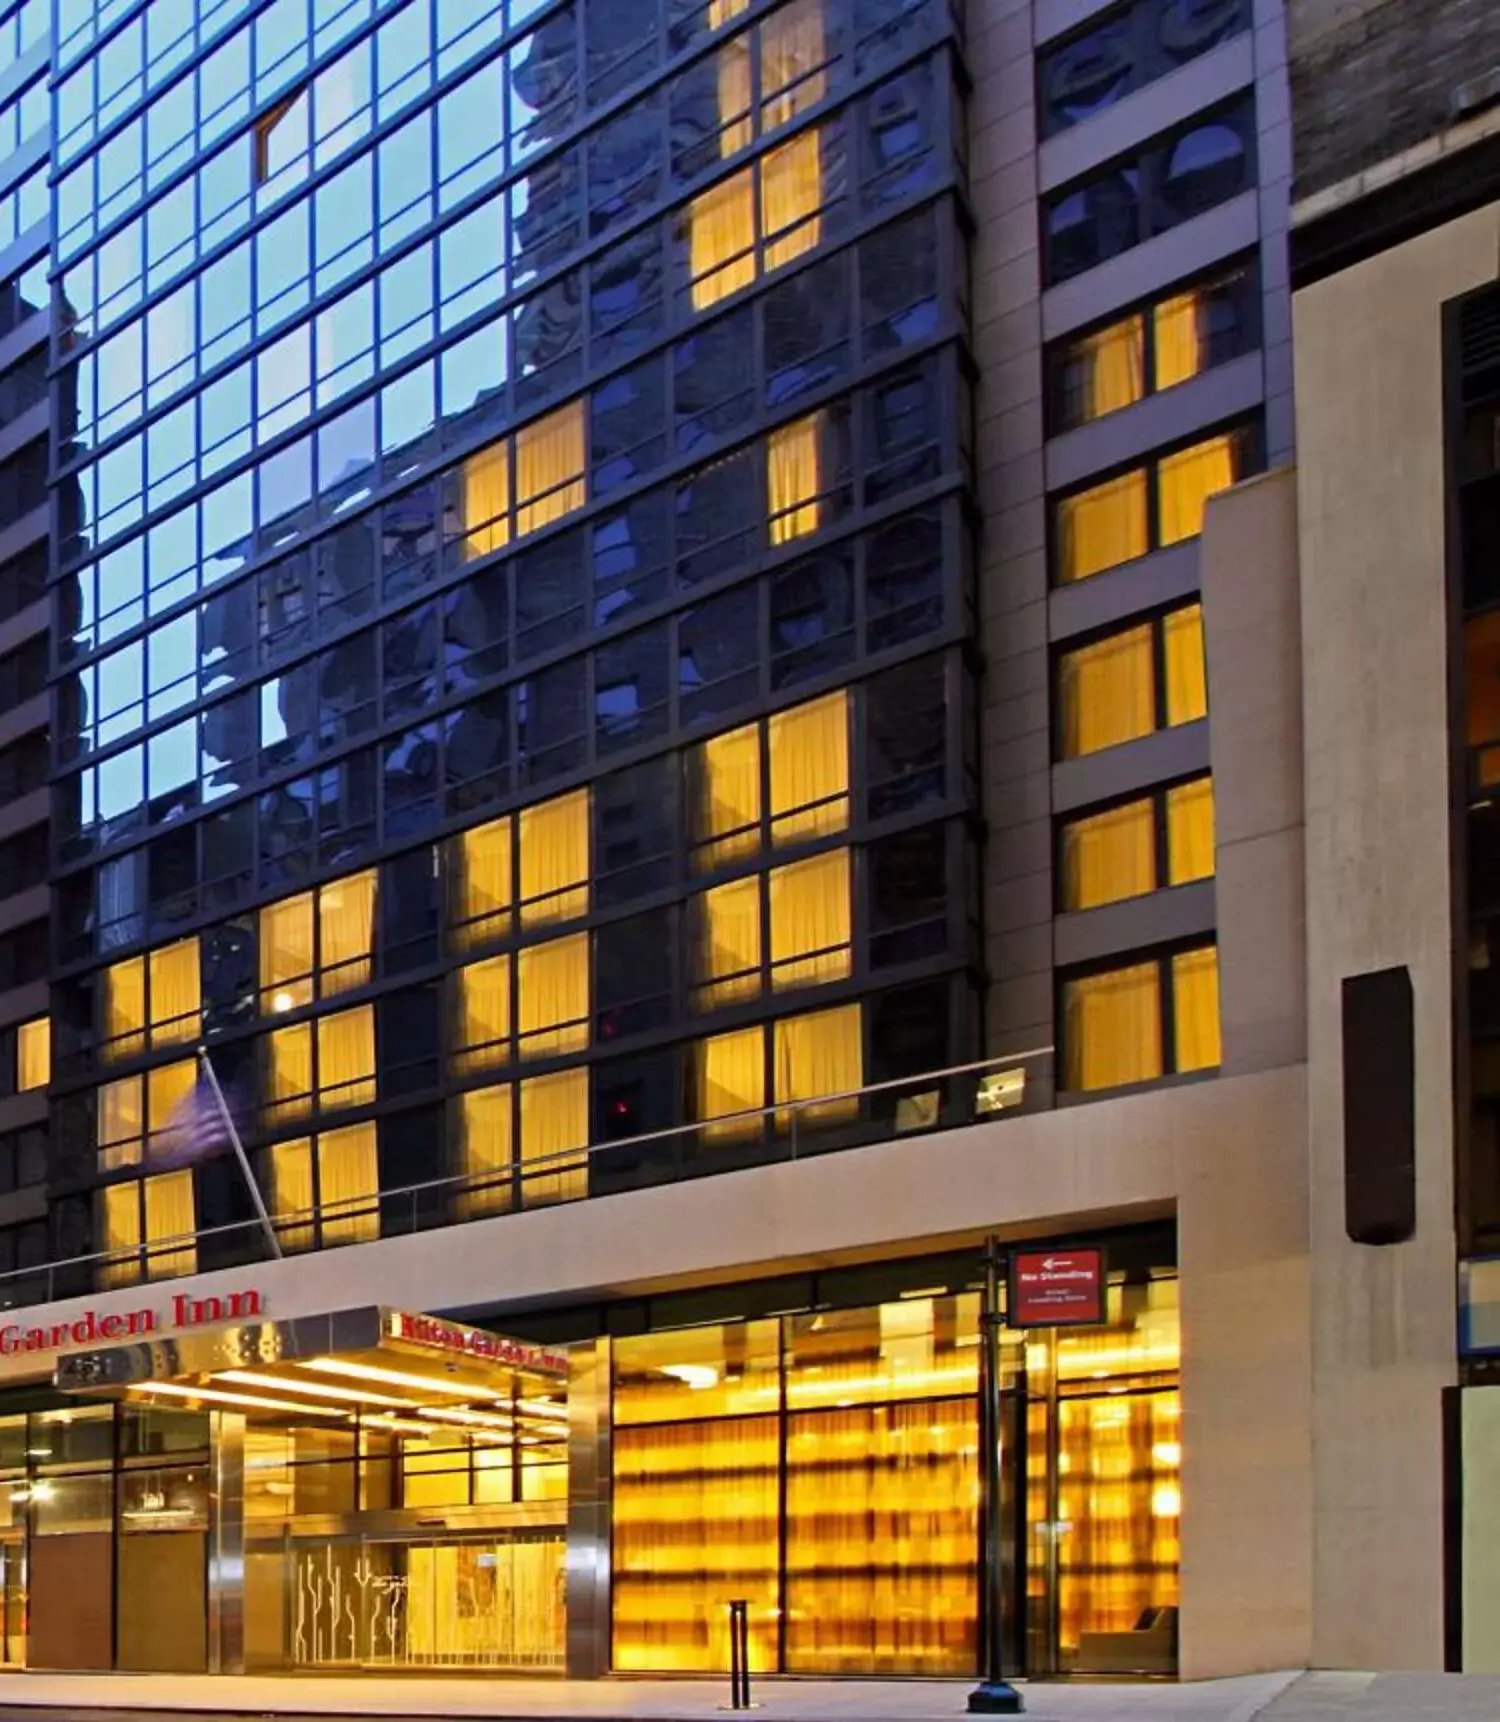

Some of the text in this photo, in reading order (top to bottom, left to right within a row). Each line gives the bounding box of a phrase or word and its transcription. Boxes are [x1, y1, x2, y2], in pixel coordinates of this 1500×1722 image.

[1021, 1271, 1093, 1281] No Standing
[171, 1288, 262, 1328] Inn
[400, 1312, 465, 1349] Hilton
